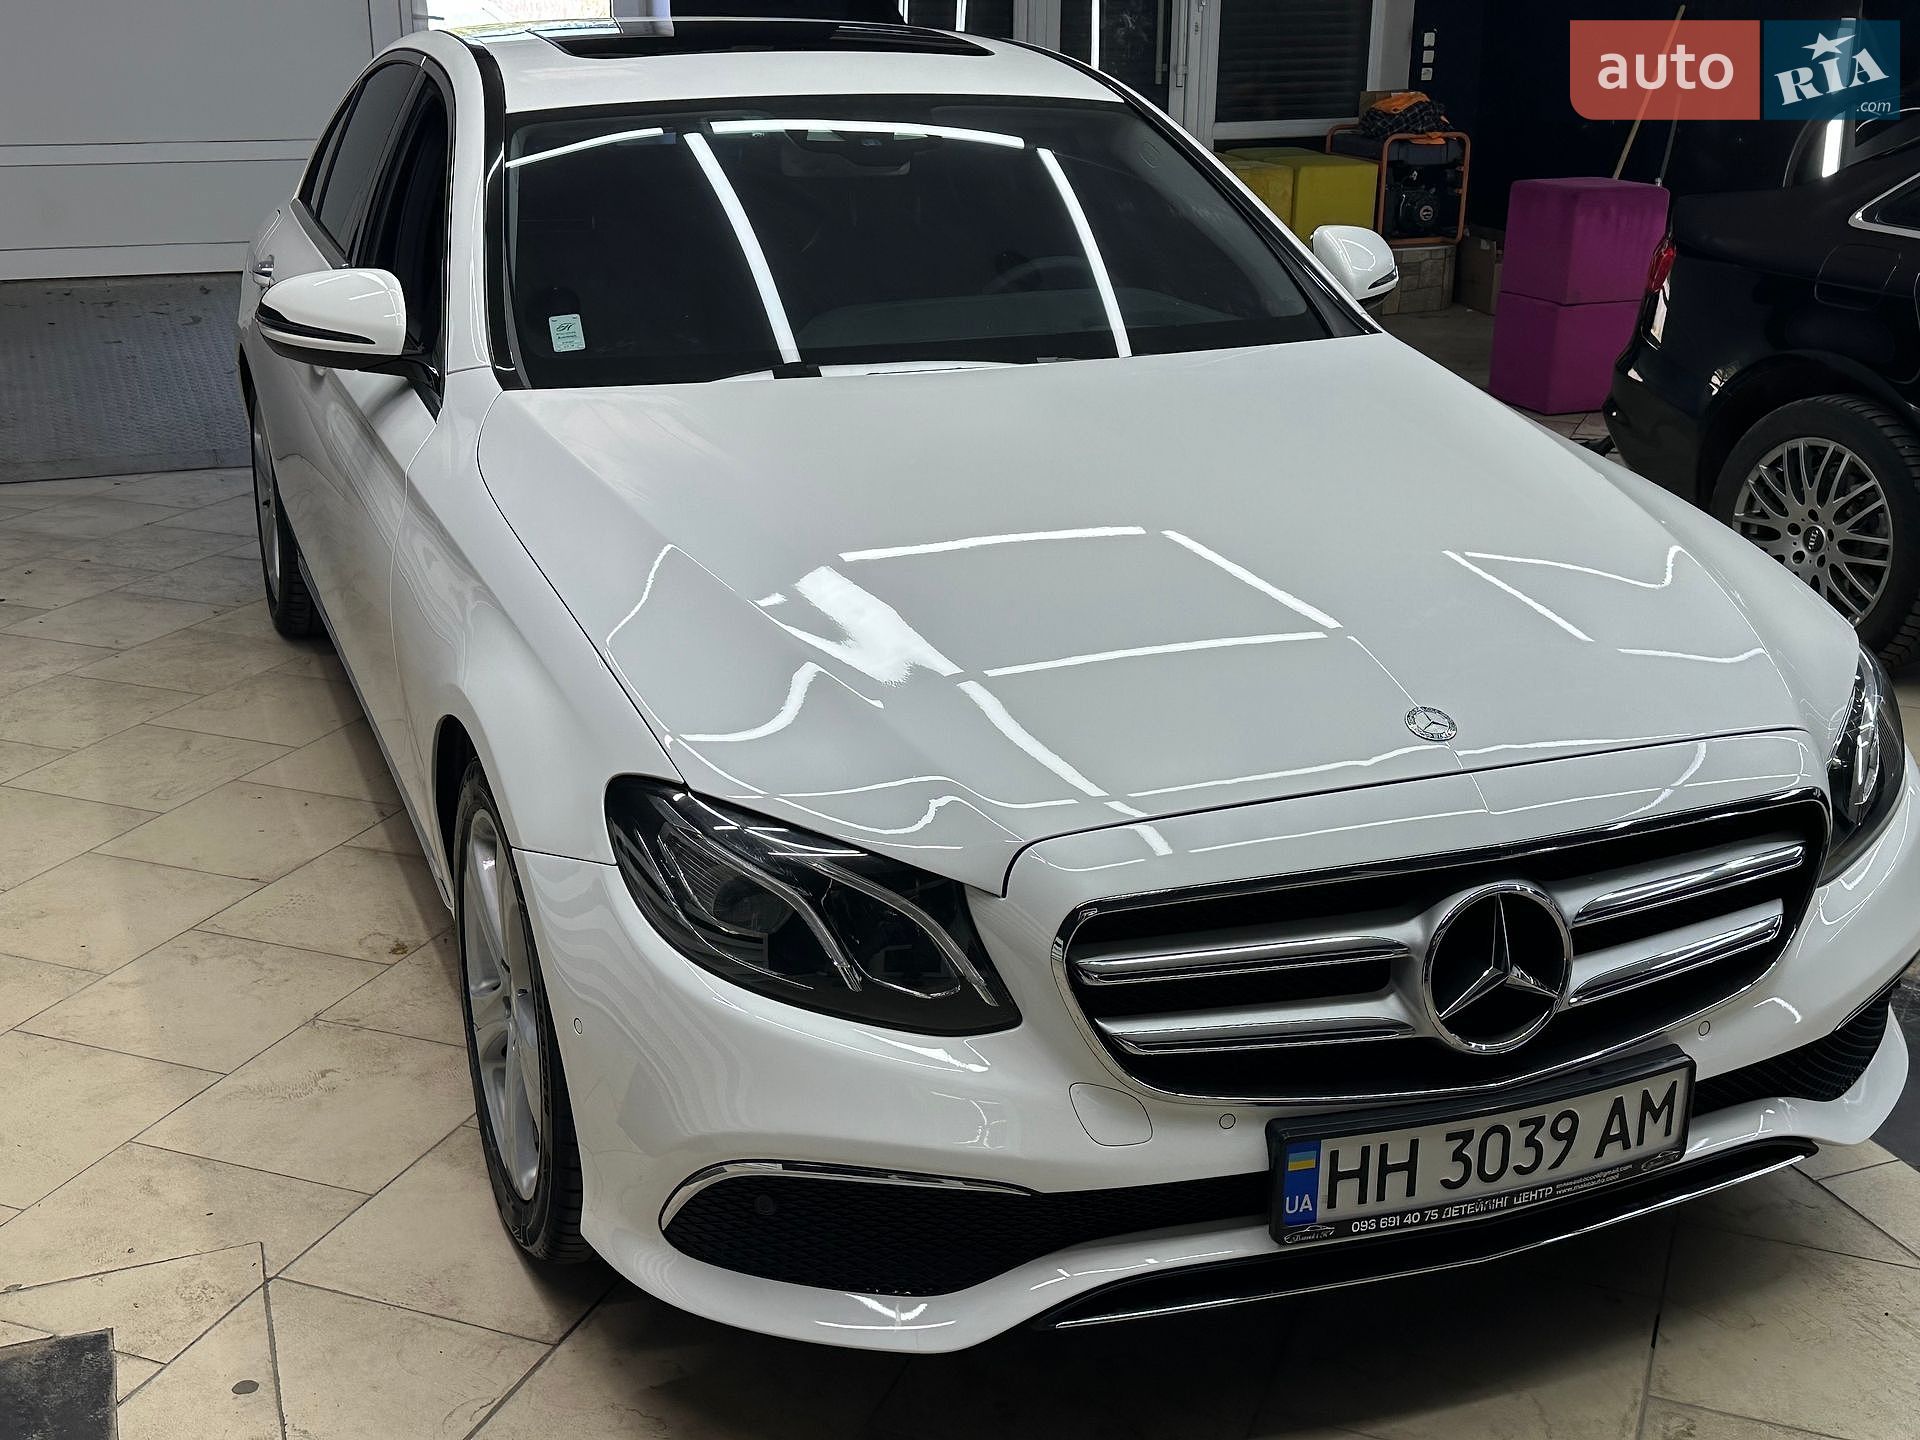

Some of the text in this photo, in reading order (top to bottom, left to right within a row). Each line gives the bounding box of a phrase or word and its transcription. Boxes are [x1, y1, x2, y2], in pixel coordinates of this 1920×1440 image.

[1326, 1080, 1678, 1210] HH 3039 AM
[1285, 1194, 1313, 1216] UA
[1351, 1219, 1377, 1233] 093
[1379, 1215, 1400, 1229] 691
[1402, 1212, 1421, 1225] 40
[1423, 1209, 1439, 1222] 75
[1513, 1186, 1553, 1205] ЦЕНТР
